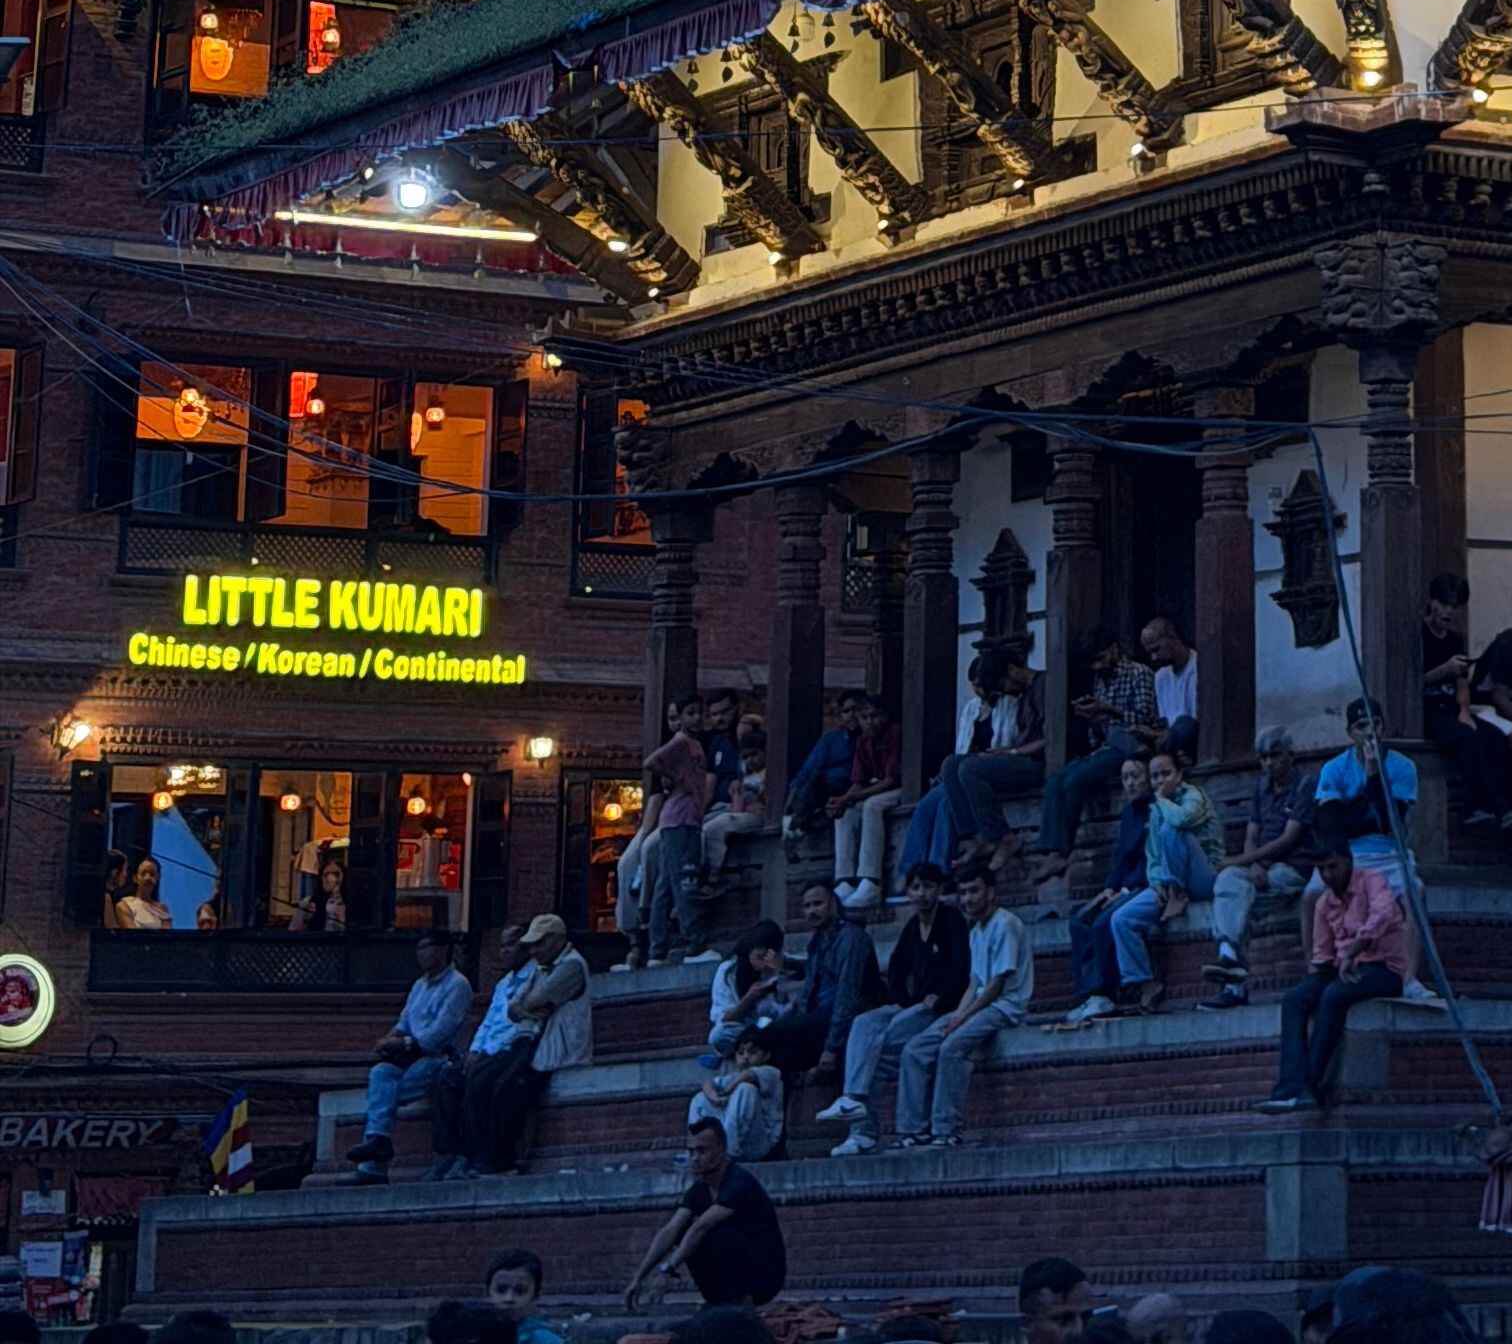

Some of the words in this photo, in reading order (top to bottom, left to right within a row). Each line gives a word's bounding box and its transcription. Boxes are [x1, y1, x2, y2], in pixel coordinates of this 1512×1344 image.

[182, 573, 322, 630] LITTLE
[328, 580, 484, 638] KUMARI
[0, 1116, 164, 1150] BAKERY
